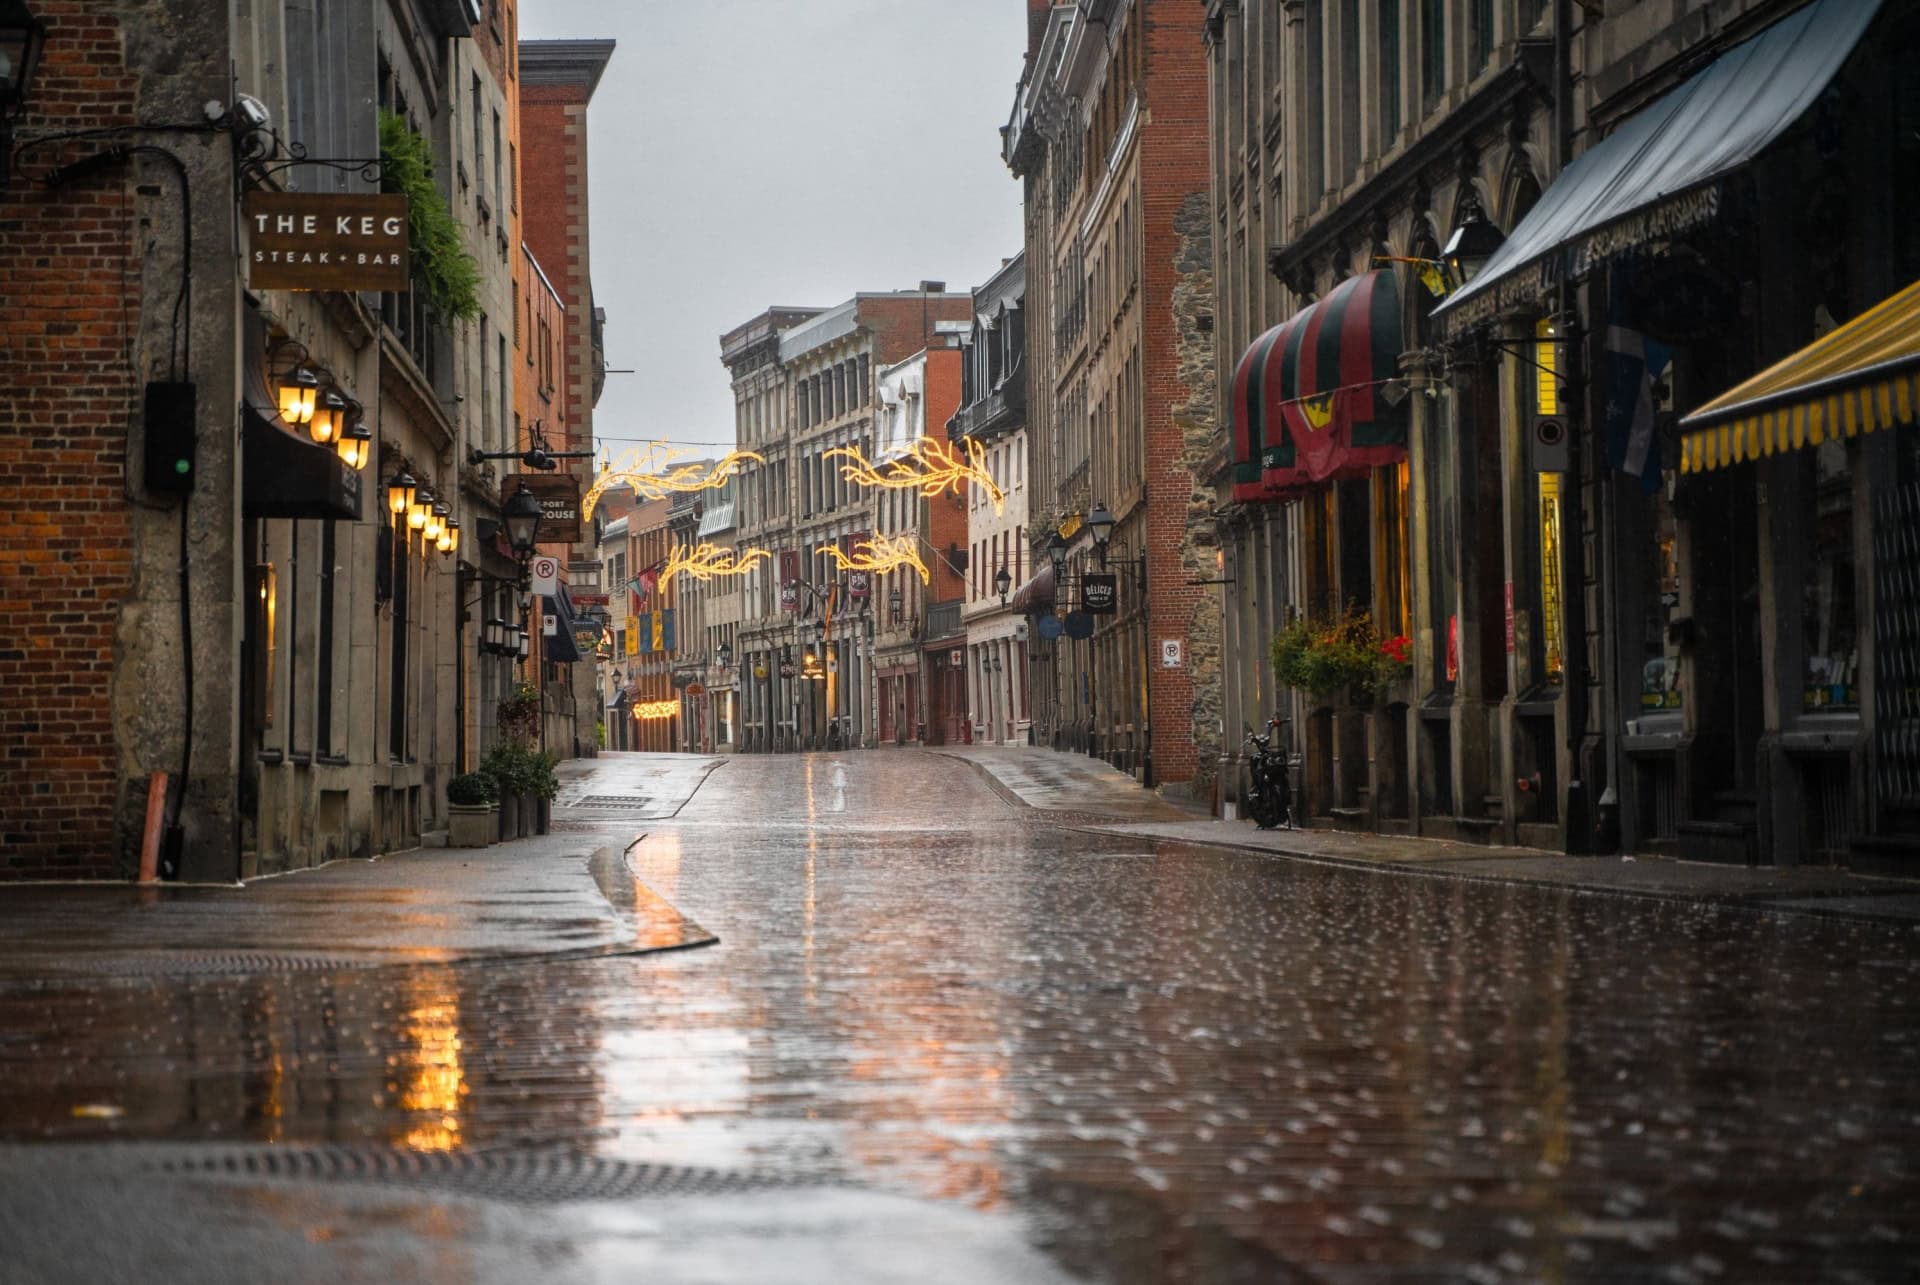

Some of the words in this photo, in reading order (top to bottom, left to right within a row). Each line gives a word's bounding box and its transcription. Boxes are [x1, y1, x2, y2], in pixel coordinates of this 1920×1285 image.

[254, 214, 317, 234] THE
[336, 216, 402, 236] KEG
[255, 251, 329, 264] STEAK
[357, 253, 400, 265] BAR
[544, 510, 575, 519] OUSE
